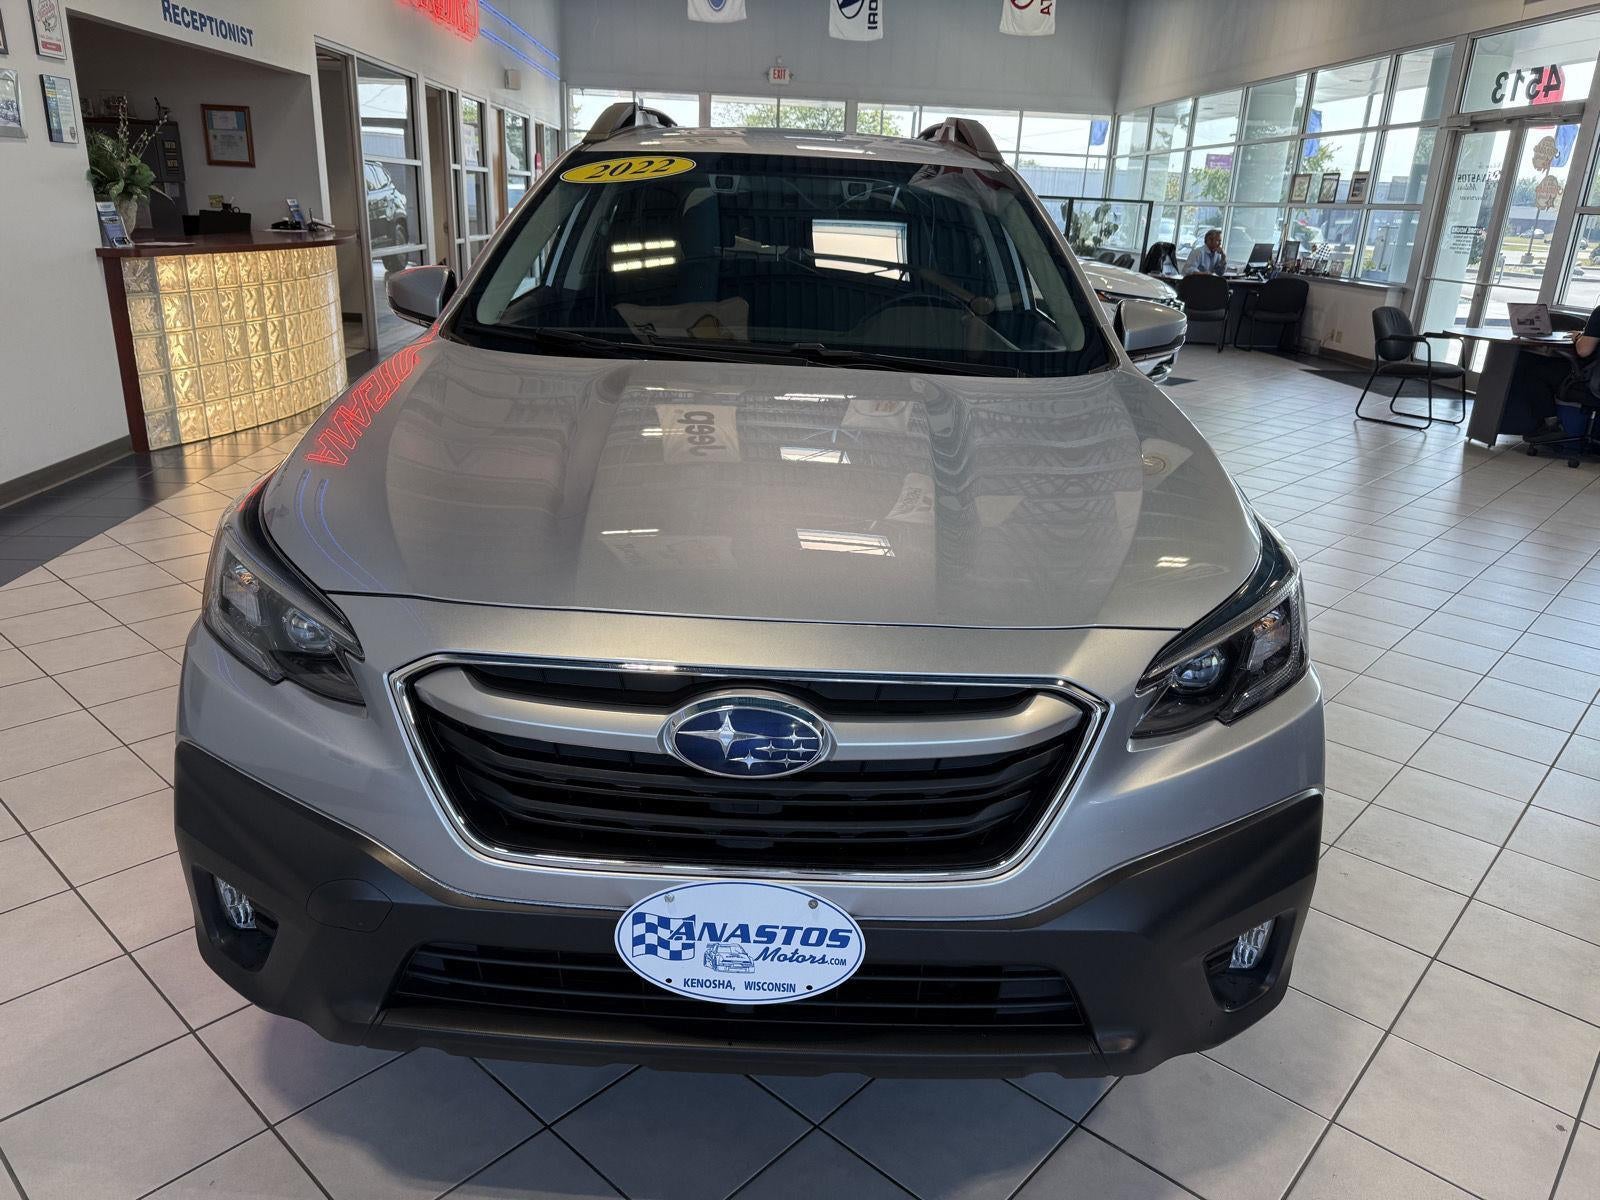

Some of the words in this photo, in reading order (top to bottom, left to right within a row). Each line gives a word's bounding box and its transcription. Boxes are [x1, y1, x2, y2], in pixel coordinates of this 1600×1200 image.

[161, 0, 253, 46] RECEPTIONIST
[773, 69, 786, 80] EXIT
[584, 159, 676, 179] 2022
[667, 920, 852, 949] ANASTOS
[683, 978, 736, 991] KENOSHA,
[744, 981, 796, 993] WISCONSIN
